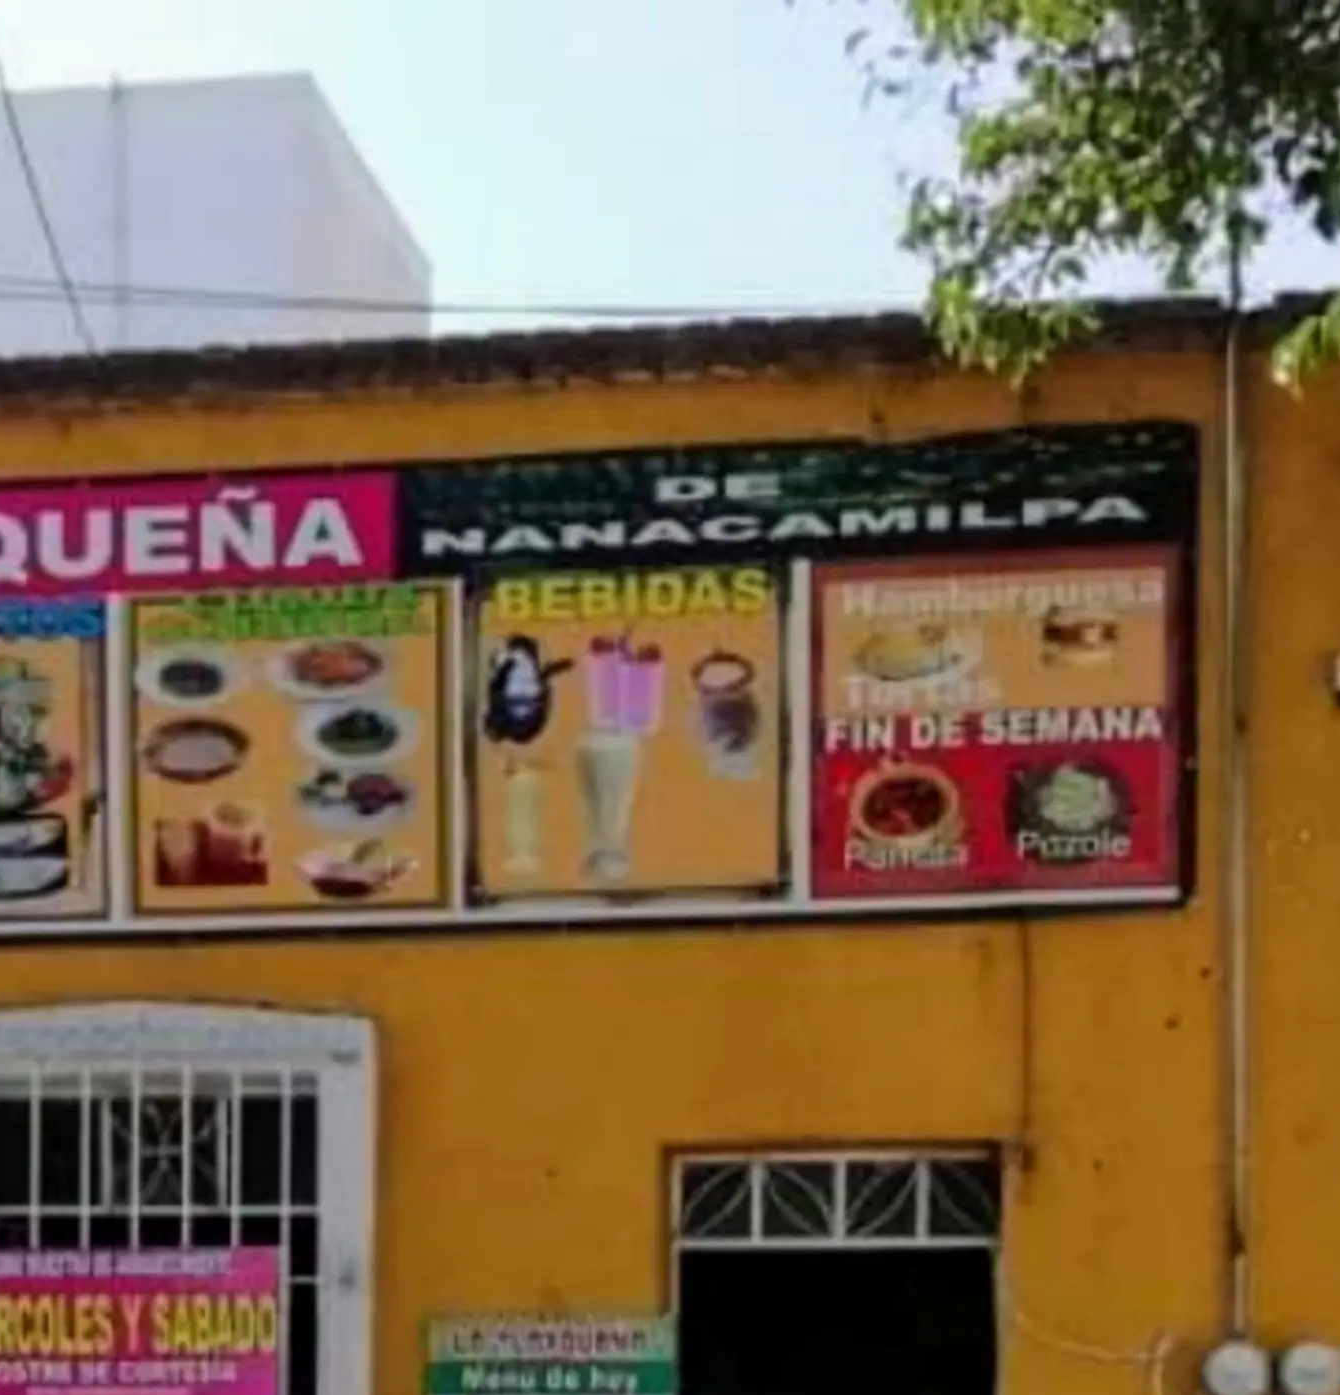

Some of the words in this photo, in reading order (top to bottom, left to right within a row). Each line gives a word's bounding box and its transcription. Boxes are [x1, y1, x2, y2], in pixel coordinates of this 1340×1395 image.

[655, 473, 780, 503] DE
[421, 496, 1147, 555] NANACAMILPA
[495, 568, 769, 620] BEBIDAS
[825, 717, 894, 751] FIN
[911, 715, 971, 749] DE
[982, 707, 1162, 745] SEMANA
[1017, 832, 1131, 859] Pozole
[121, 1294, 144, 1354] Y
